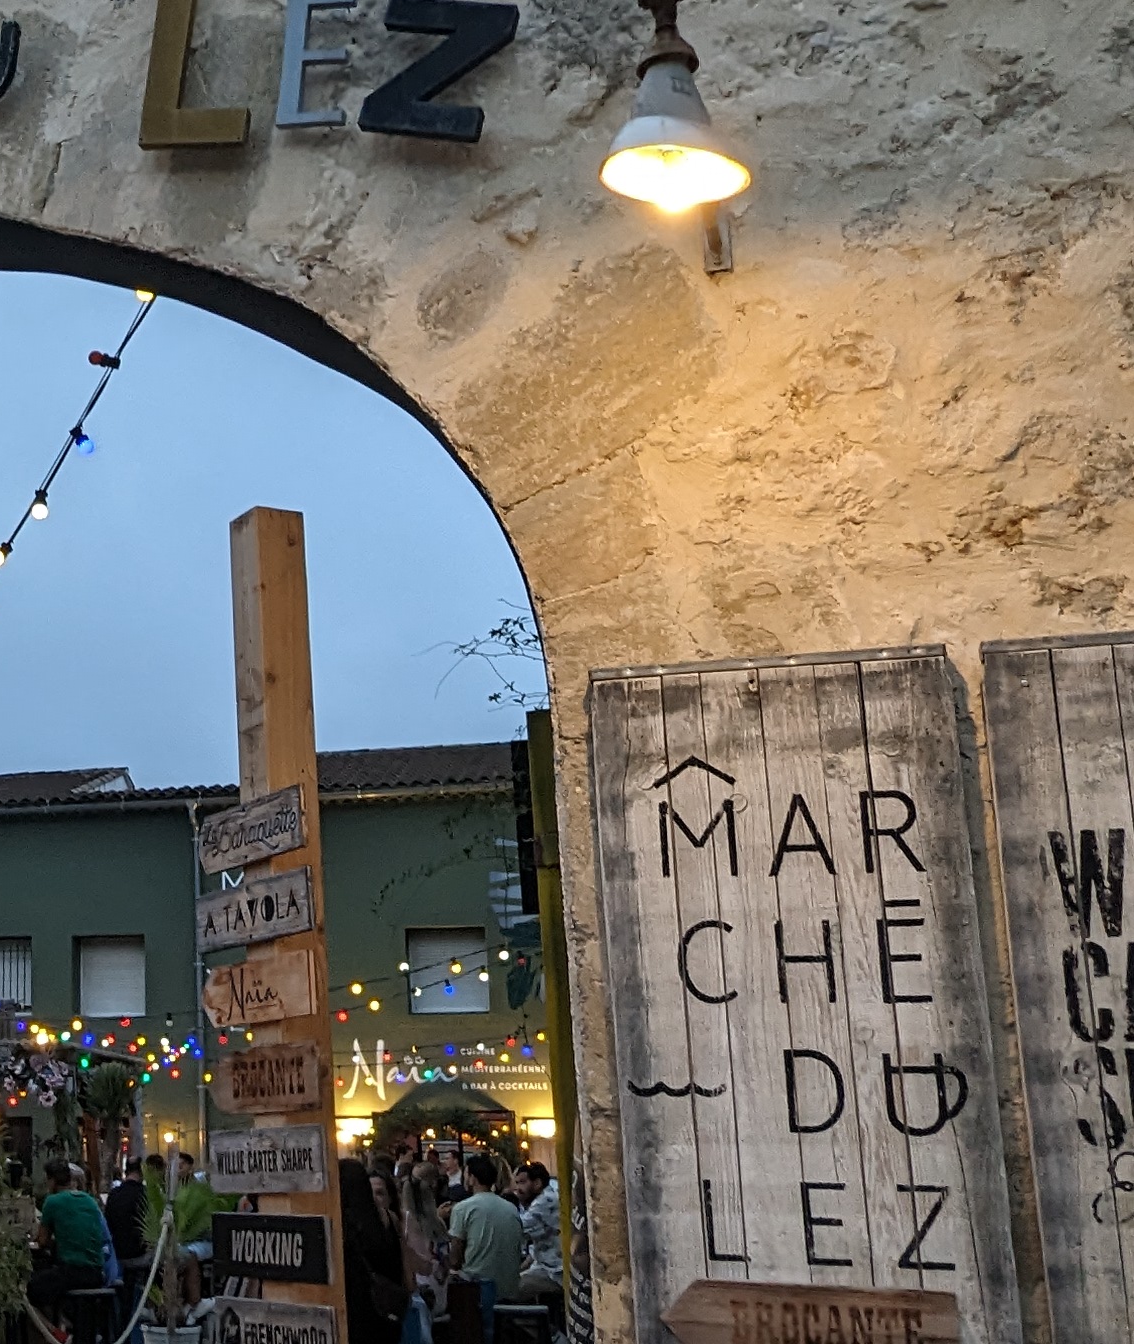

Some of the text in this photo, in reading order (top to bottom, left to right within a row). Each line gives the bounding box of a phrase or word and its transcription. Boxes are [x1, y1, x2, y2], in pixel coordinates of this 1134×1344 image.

[204, 889, 300, 938] A TAVOLA
[216, 1147, 314, 1175] WILLIE CARTER SHARPE
[231, 1228, 303, 1267] WORKING
[701, 1179, 956, 1272] LEZ
